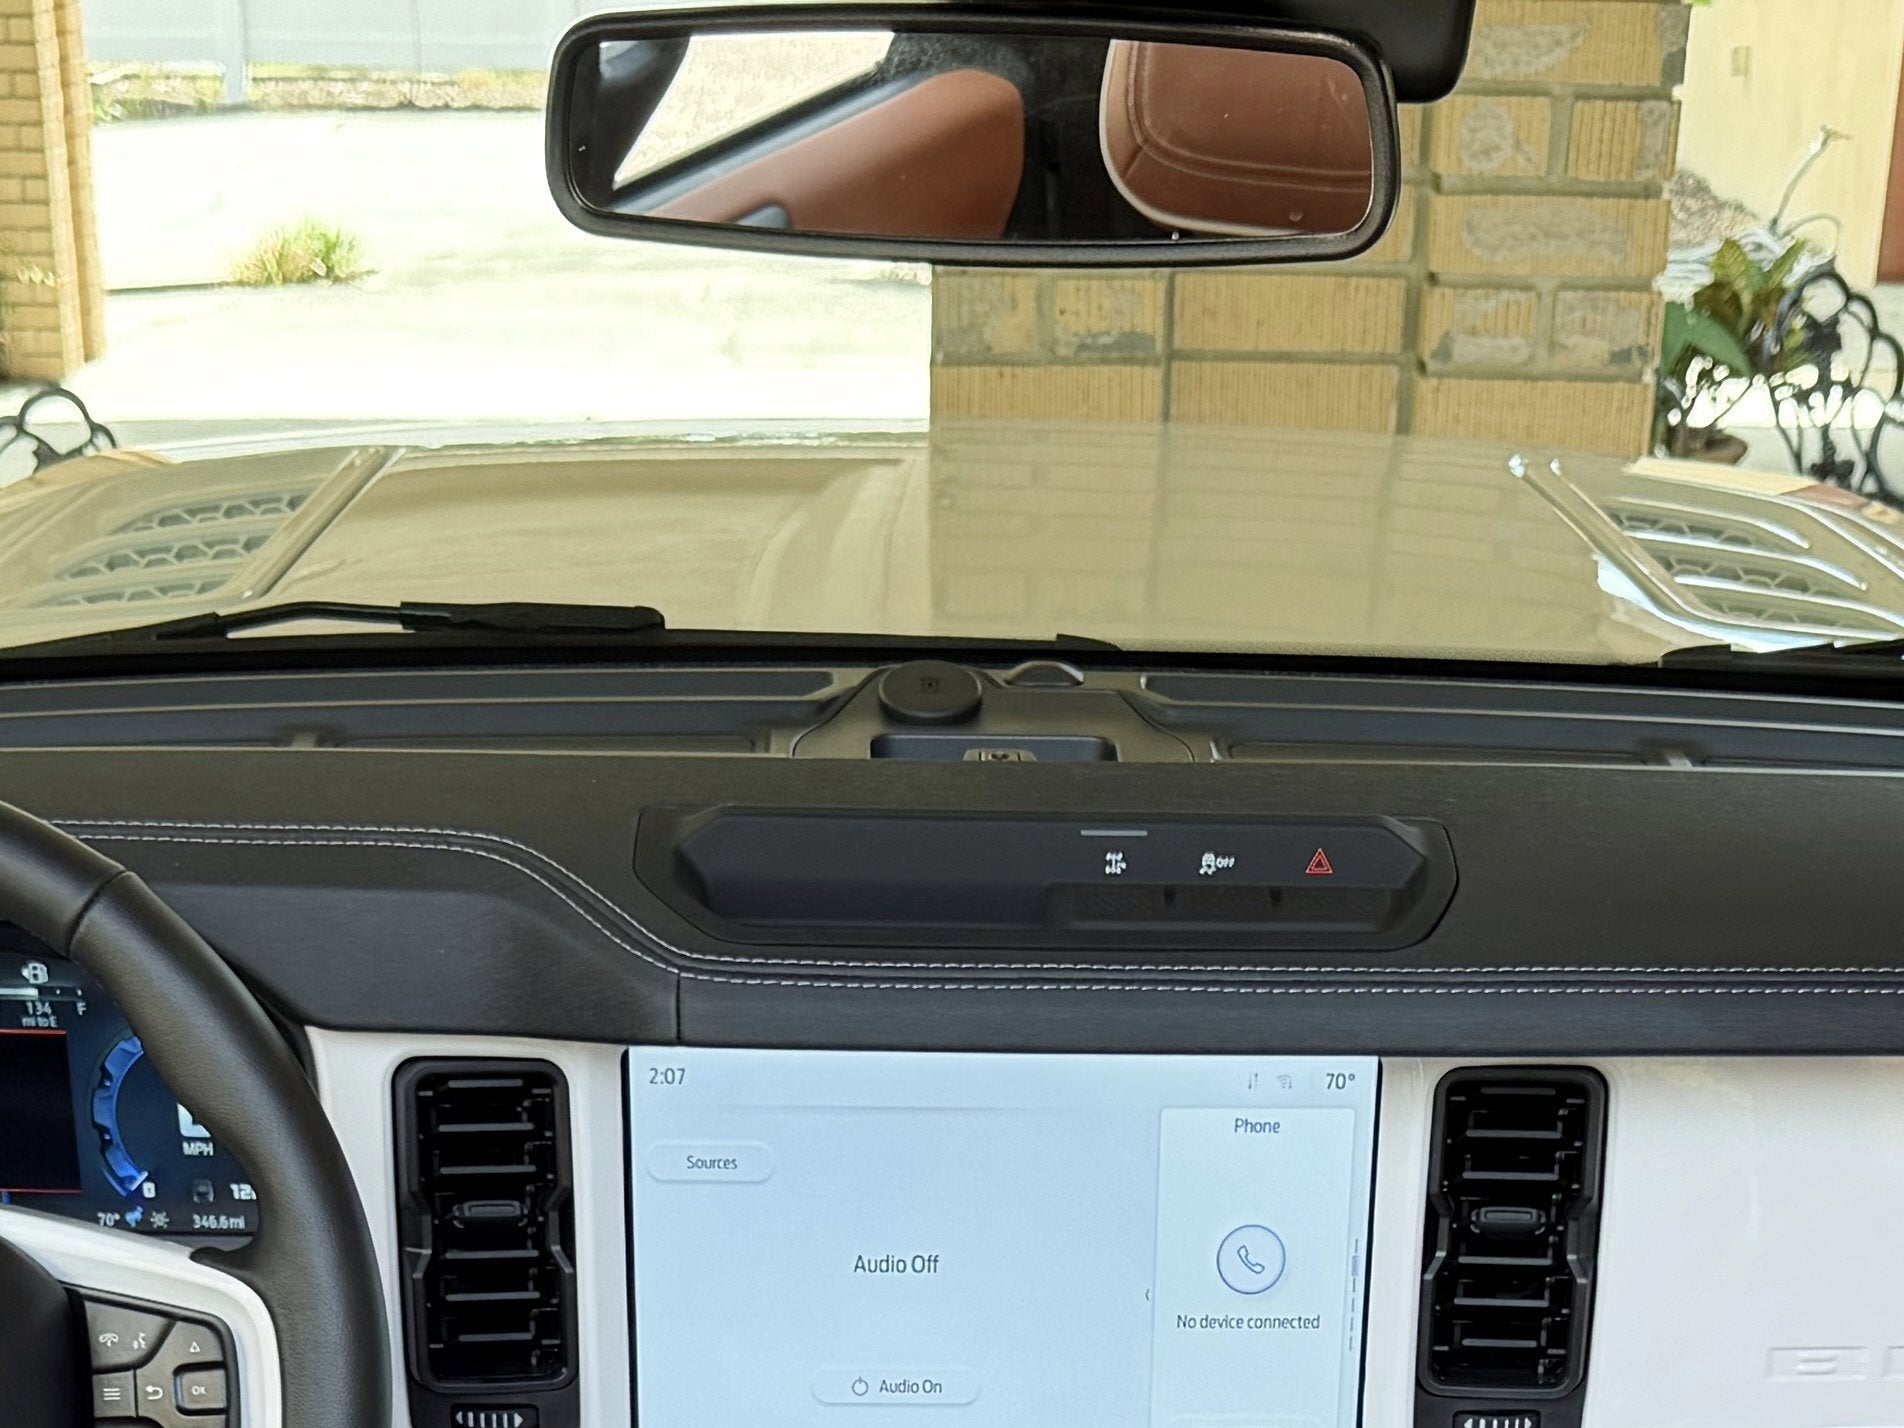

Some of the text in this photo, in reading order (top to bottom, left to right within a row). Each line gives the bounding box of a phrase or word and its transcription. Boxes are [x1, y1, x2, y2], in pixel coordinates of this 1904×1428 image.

[77, 1002, 86, 1015] F
[649, 1068, 686, 1085] 2:07
[1326, 1073, 1356, 1090] 70°
[1234, 1118, 1280, 1133] Phone
[182, 1141, 214, 1156] MPH
[686, 1155, 738, 1170] Sources
[854, 1254, 939, 1273] Audio Off
[1177, 1314, 1320, 1329] No device connected
[191, 1385, 207, 1396] OK
[880, 1379, 943, 1394] Audio On
